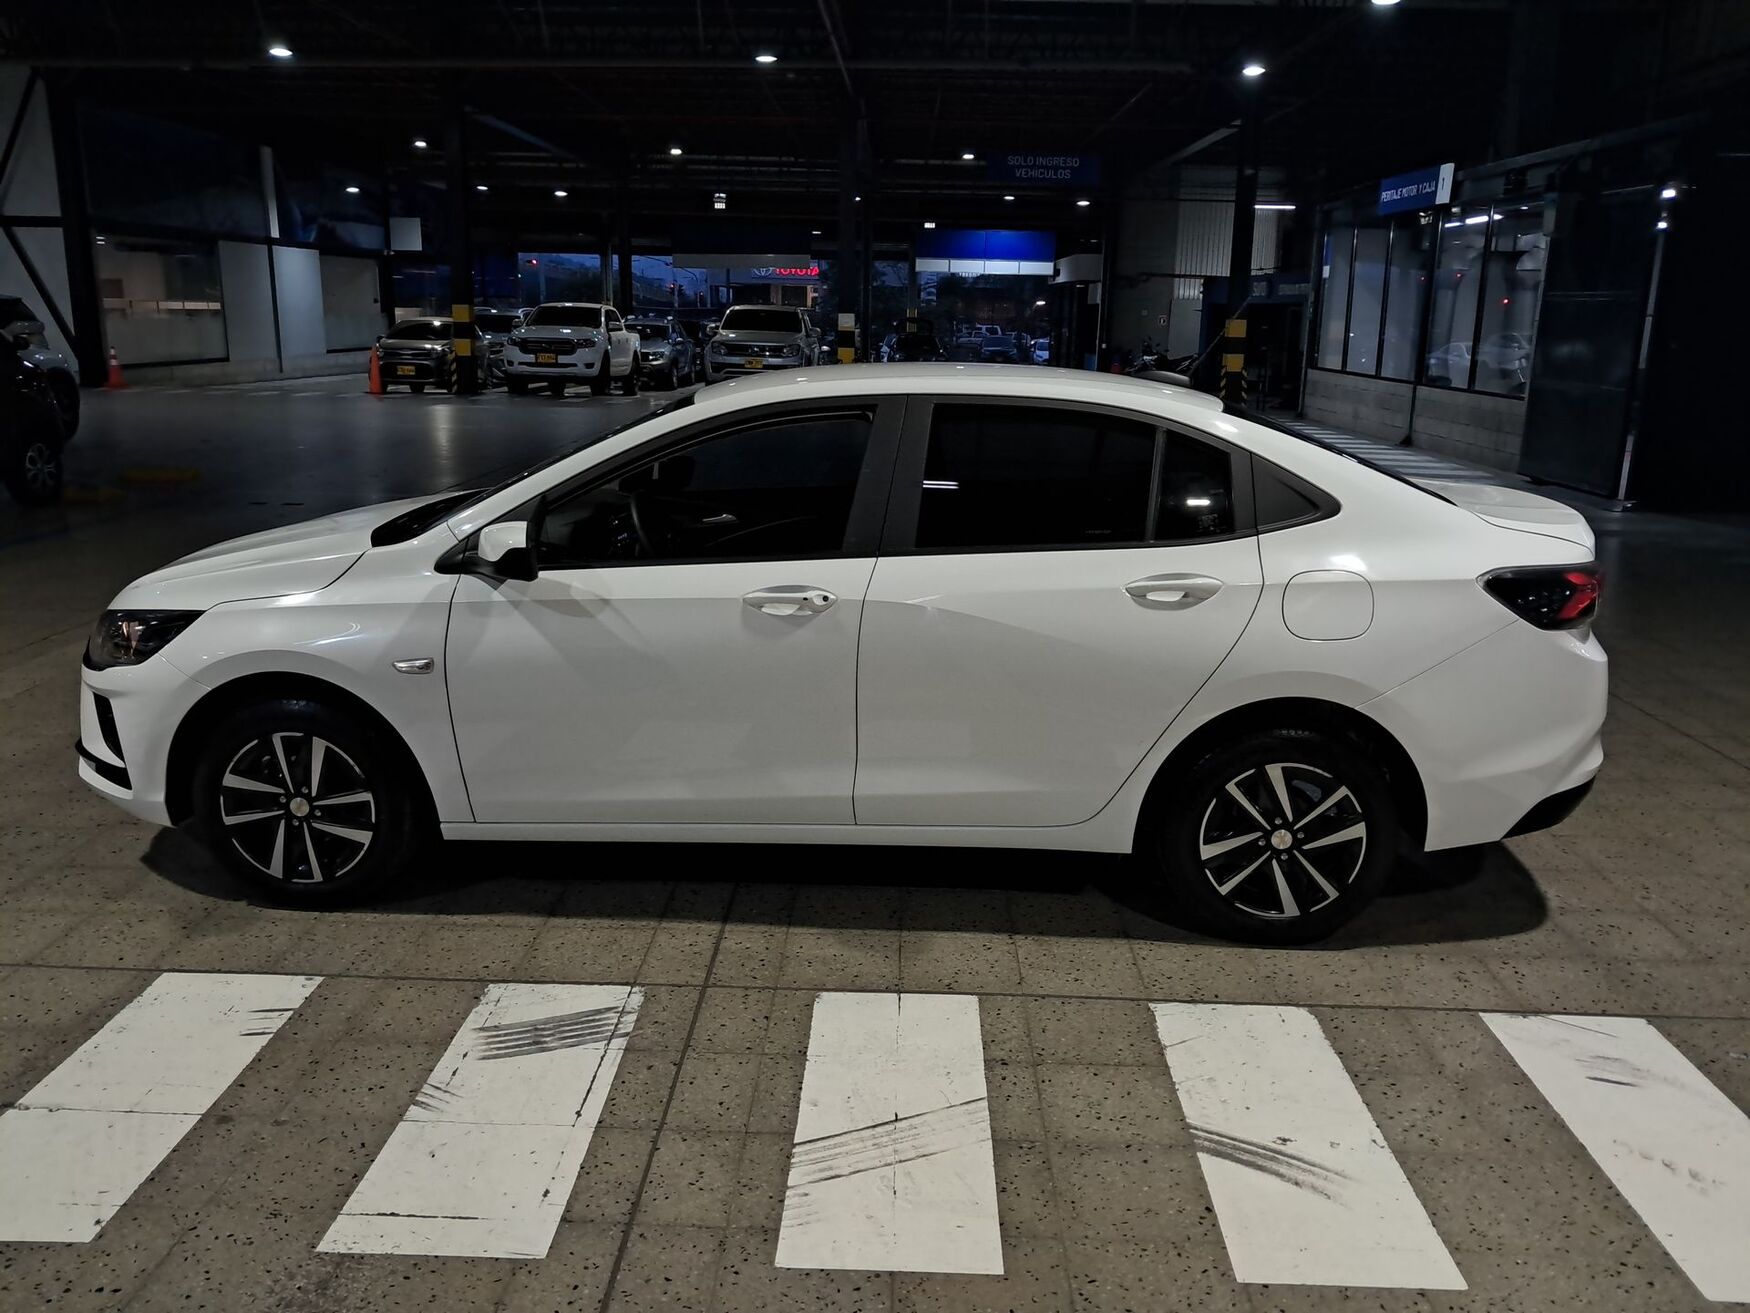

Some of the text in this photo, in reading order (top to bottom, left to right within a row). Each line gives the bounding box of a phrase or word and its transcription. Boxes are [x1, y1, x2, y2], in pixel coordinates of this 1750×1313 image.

[1007, 155, 1080, 168] SOLO INGRESO
[1381, 187, 1402, 202] PERITAJE
[1402, 184, 1418, 197] MOTOR
[1422, 180, 1436, 194] CAJA
